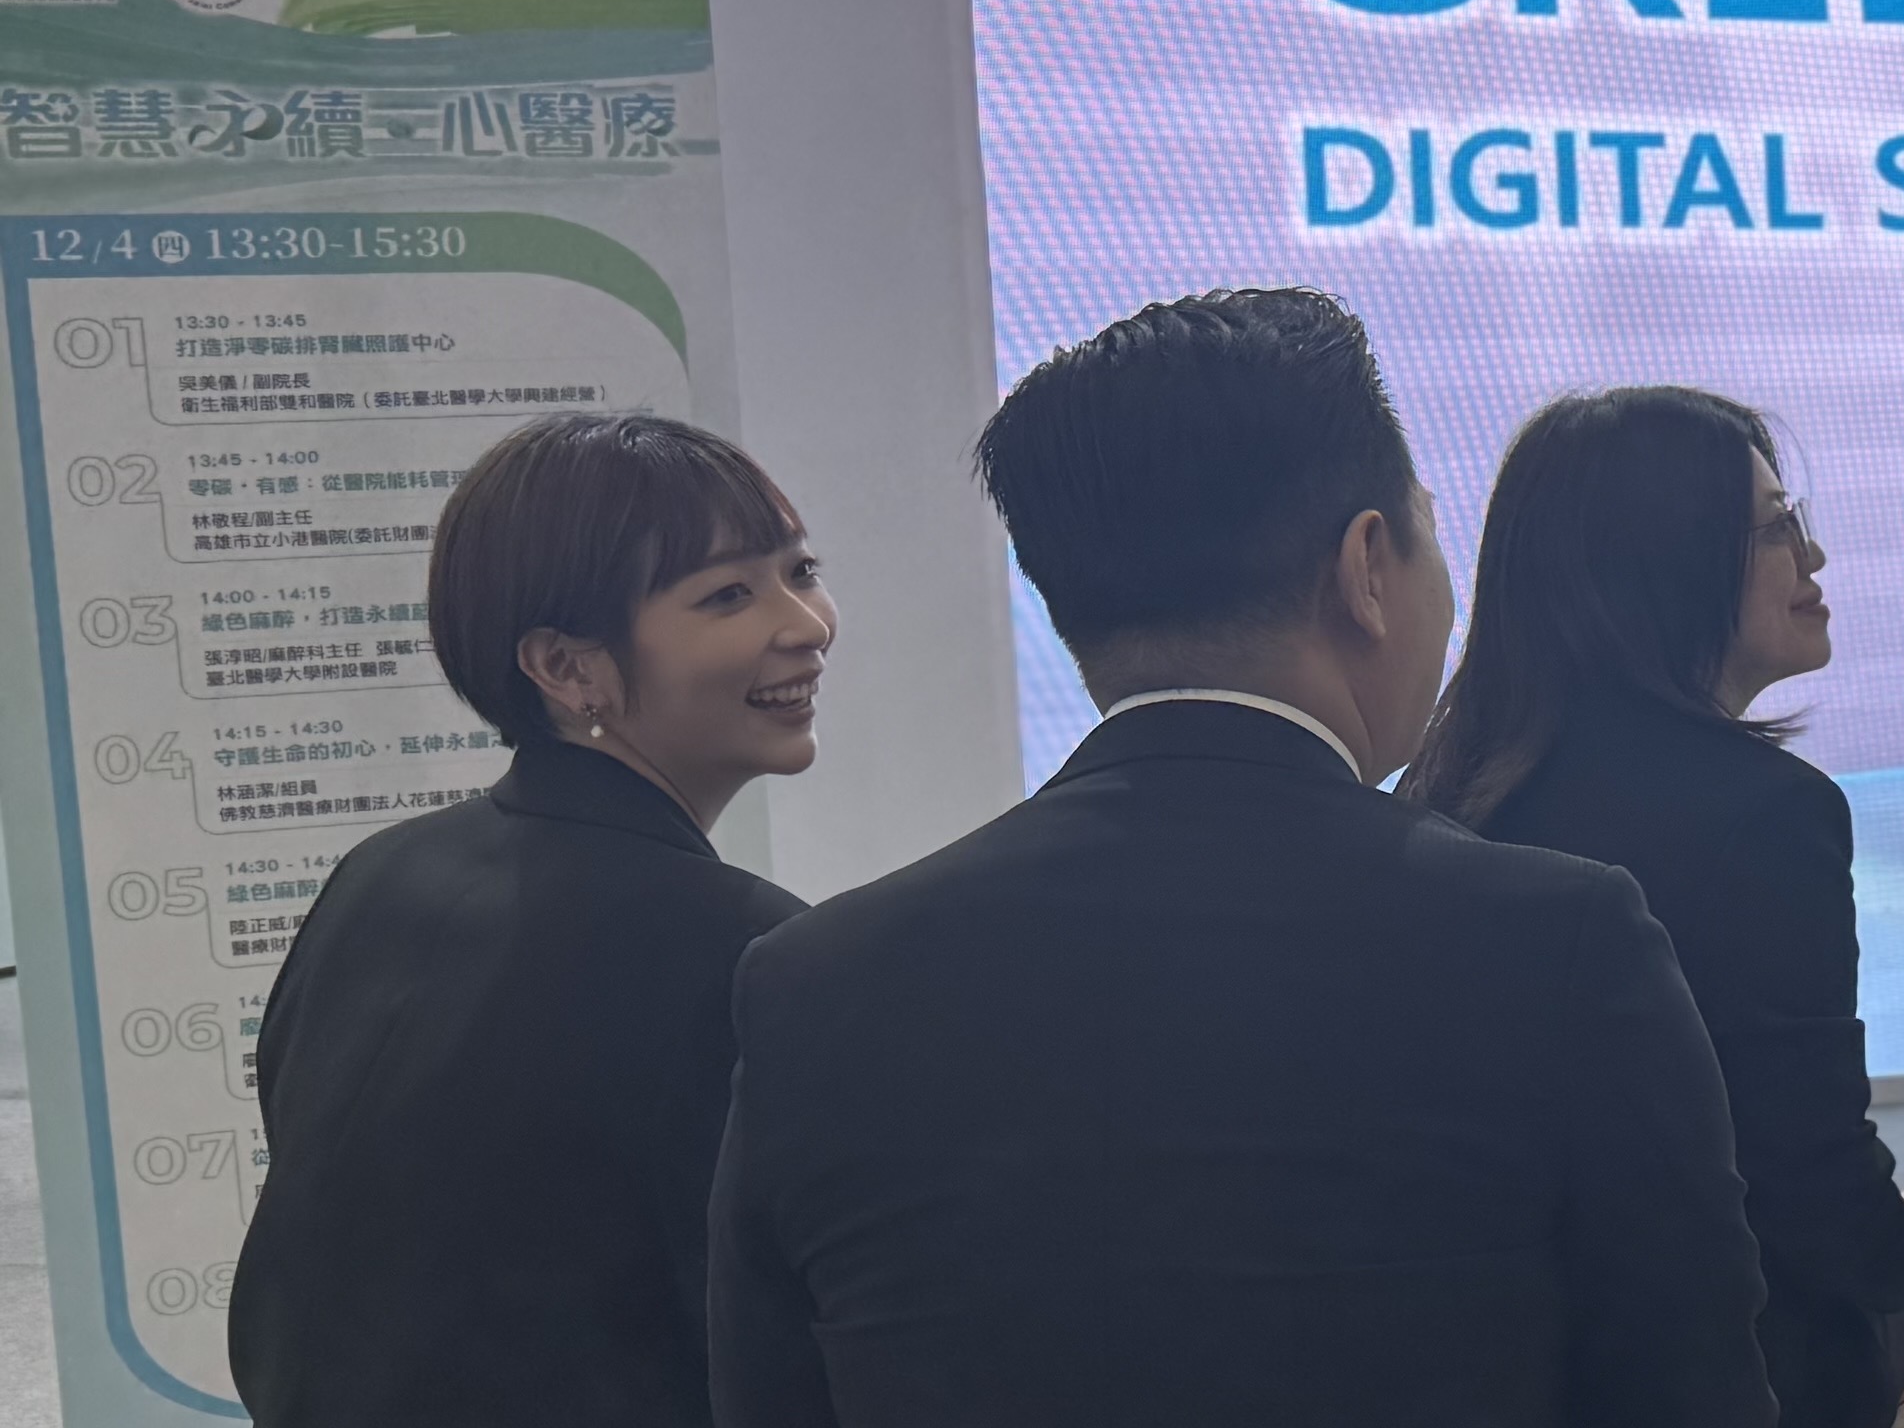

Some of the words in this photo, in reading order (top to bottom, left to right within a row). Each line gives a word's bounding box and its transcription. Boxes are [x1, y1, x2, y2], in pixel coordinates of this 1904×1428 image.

[1302, 126, 1824, 230] DIGITAL
[206, 224, 467, 260] 13:30-15:30
[175, 315, 229, 330] 13:30
[253, 314, 307, 328] 13:45
[54, 318, 148, 369] 01
[253, 372, 311, 390] 副院長
[188, 453, 241, 468] 13:45
[265, 451, 319, 465] 14:00
[67, 454, 162, 505] 02
[194, 524, 437, 551] 高雄市立小港醫院(委託財團
[201, 589, 255, 605] 14:00
[278, 586, 331, 601] 14:15
[80, 595, 178, 648] 03
[206, 661, 398, 687] 臺北醫學大學附設醫院
[213, 725, 266, 740] 14:15
[290, 720, 343, 735] 14:30
[95, 731, 193, 784] 04
[226, 859, 279, 875] 14:30
[108, 868, 209, 920] 05
[231, 935, 297, 956] 醫療財
[121, 1003, 222, 1057] 06
[133, 1130, 236, 1186] 07
